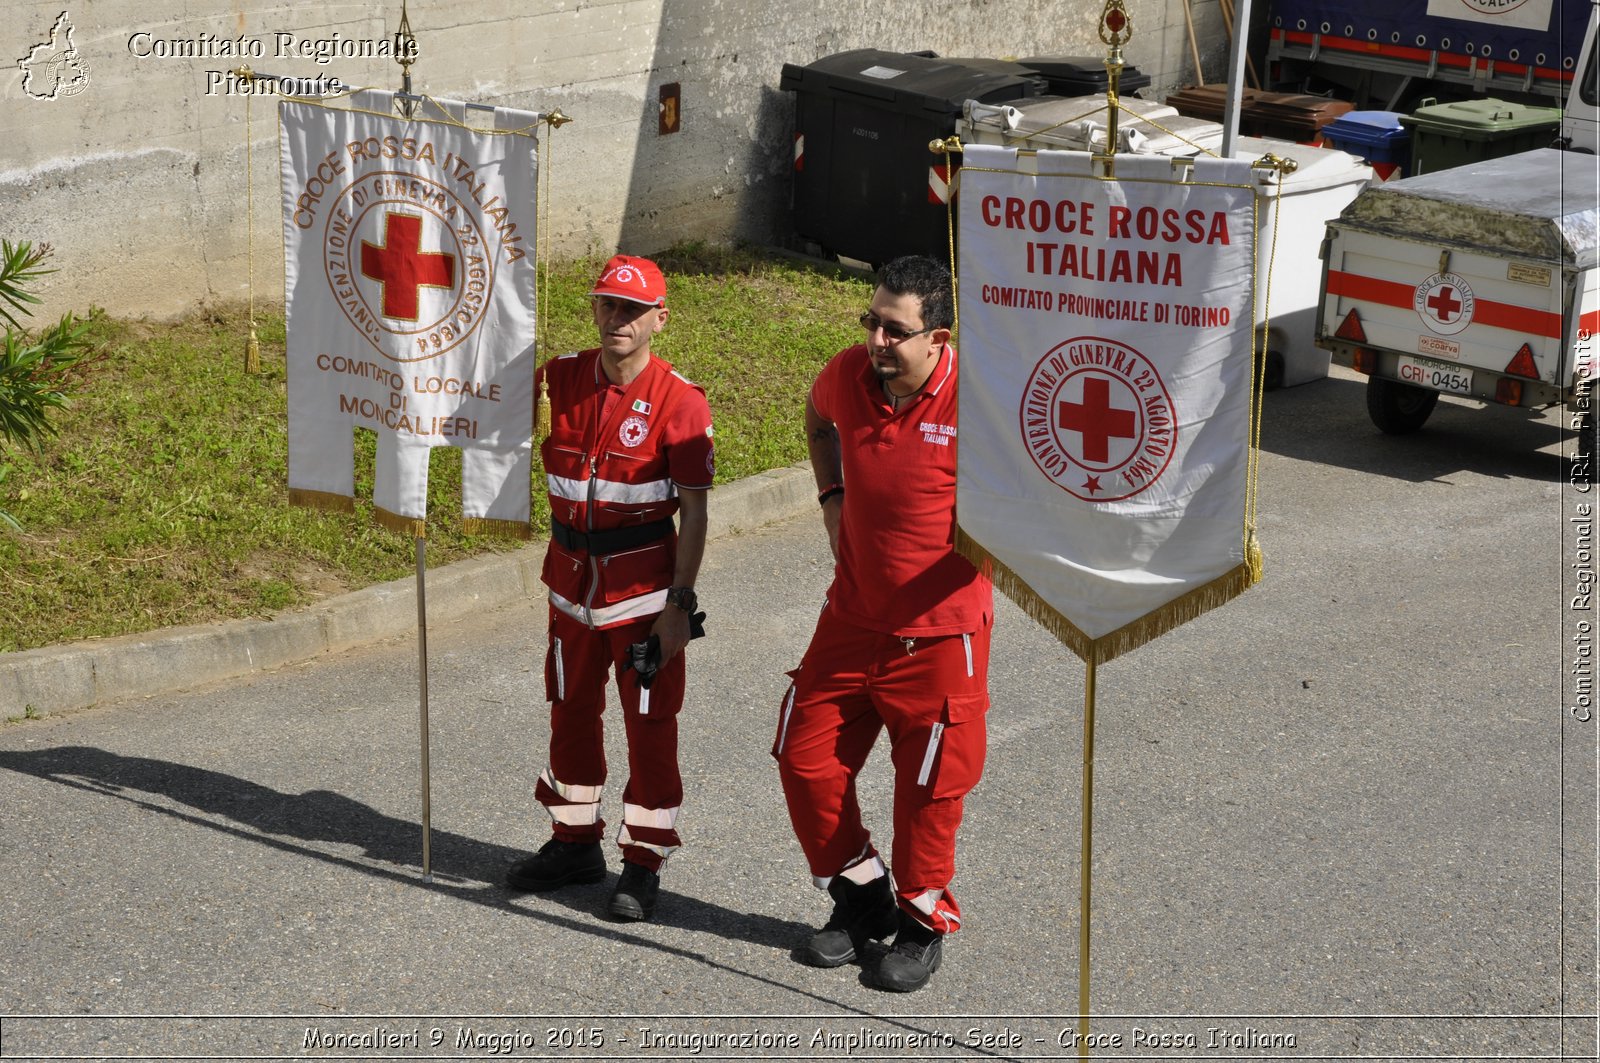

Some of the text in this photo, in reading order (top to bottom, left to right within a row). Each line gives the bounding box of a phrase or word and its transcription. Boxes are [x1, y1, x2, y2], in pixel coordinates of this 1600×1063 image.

[293, 136, 526, 265] CROCE ROSSA ITALIANA
[352, 186, 369, 208] DI
[374, 178, 459, 221] GINEVRA
[456, 223, 479, 249] 22
[981, 194, 1231, 246] CROCE ROSSA
[329, 208, 381, 343] CONVENZIONE
[1026, 241, 1183, 287] ITALIANA
[456, 254, 486, 324] AGOSTO
[982, 284, 1230, 328] COMITATO PROVINCIALE DI TORINO
[1416, 280, 1433, 305] CROCE
[1456, 278, 1473, 313] ITALIANA
[1413, 357, 1461, 373] RIMORCHIO
[1430, 342, 1458, 353] coarva
[316, 354, 502, 402] COMITATO LOCALE
[1401, 364, 1469, 391] CRI 0454
[339, 394, 478, 439] MONCALIERI
[390, 391, 407, 412] DI
[1027, 344, 1171, 488] CONVENZIONE DI GINEVRA 22 AGOSTO 1864
[920, 422, 938, 432] CROCE
[924, 432, 949, 446] ITALIANA
